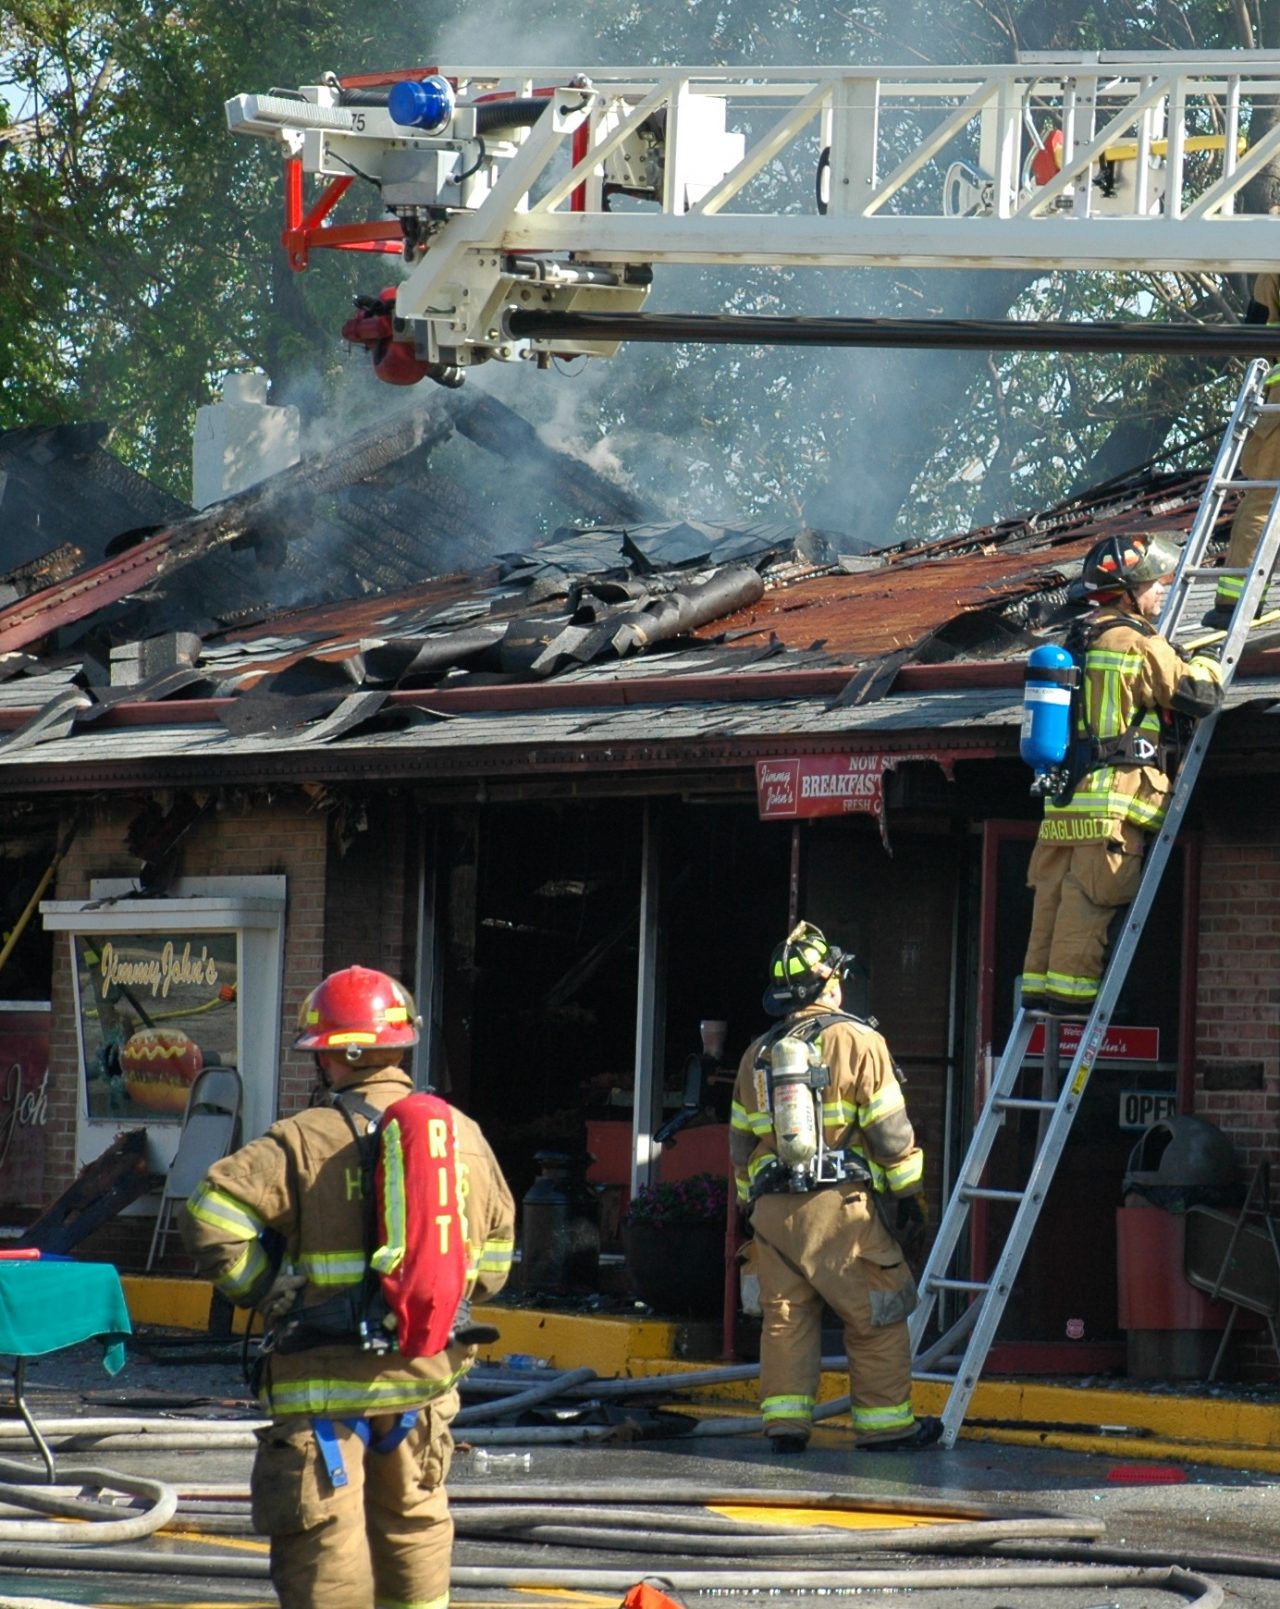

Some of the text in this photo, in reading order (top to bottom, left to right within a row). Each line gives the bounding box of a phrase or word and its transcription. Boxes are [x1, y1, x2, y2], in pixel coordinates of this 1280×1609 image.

[849, 755, 877, 771] NOW
[760, 764, 792, 789] Jimmy
[765, 785, 794, 811] John's
[842, 799, 871, 812] FRESH
[101, 941, 218, 998] Jimmy John's
[428, 1118, 452, 1255] RIT
